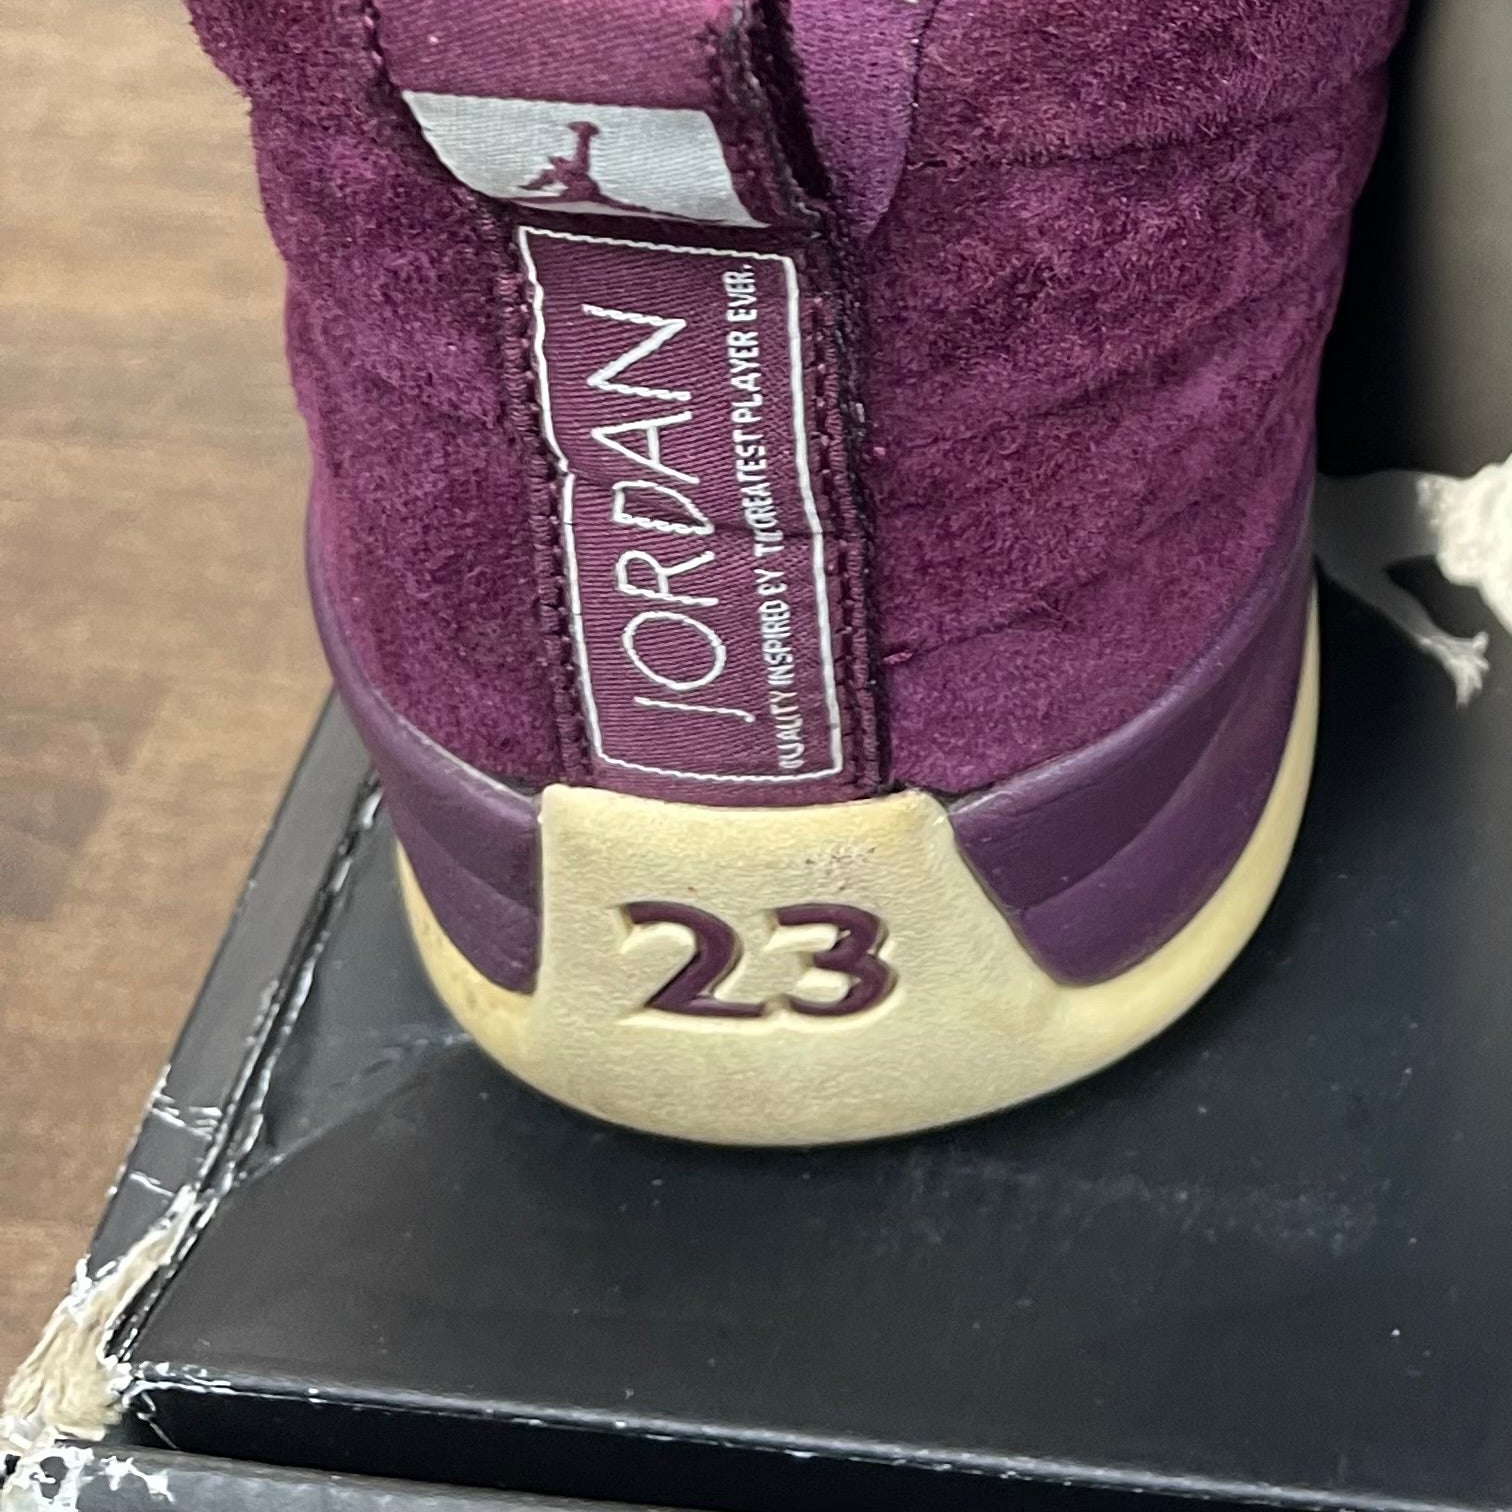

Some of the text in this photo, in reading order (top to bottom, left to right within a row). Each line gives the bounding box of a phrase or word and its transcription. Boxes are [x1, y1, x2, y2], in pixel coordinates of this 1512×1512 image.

[722, 263, 759, 322] EVER.
[726, 330, 764, 424] PLAYER
[582, 303, 756, 723] JORDAN
[752, 567, 788, 596] BY
[758, 598, 796, 686] INSPIRED
[768, 689, 806, 770] QUALITY
[623, 899, 899, 1019] 23
